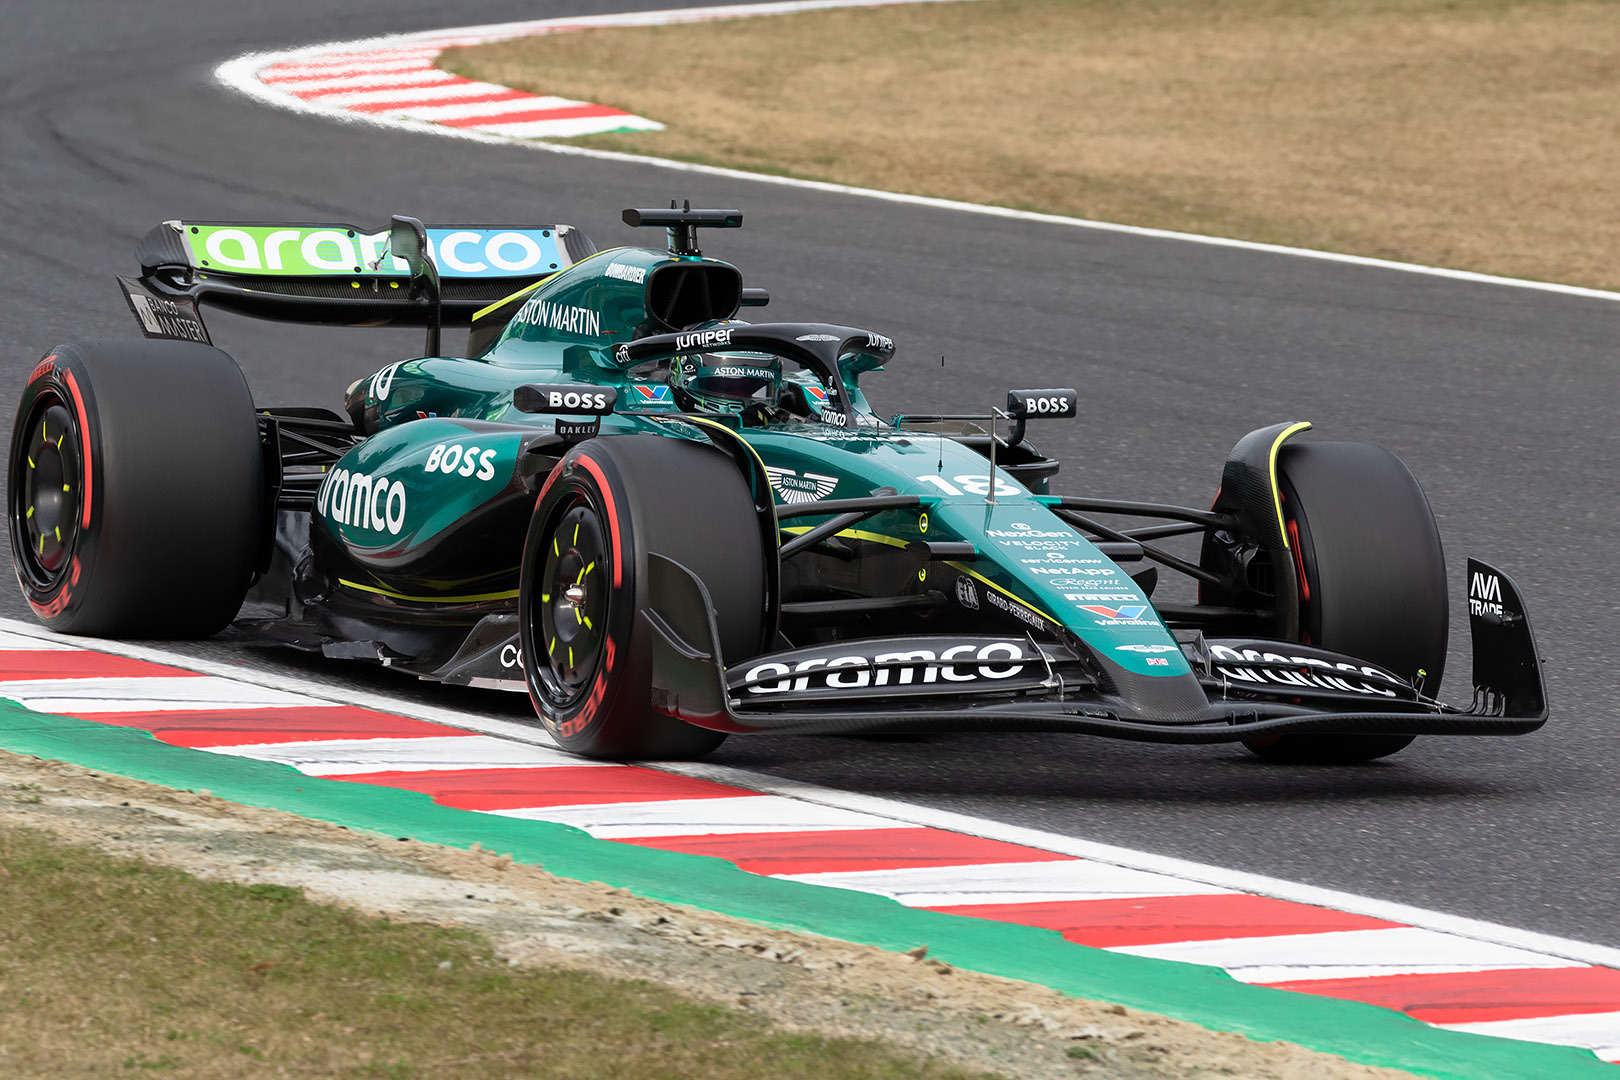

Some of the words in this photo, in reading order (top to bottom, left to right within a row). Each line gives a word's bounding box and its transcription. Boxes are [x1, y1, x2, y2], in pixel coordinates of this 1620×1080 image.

[147, 298, 178, 316] BANCO
[513, 299, 550, 328] ASTON
[549, 302, 600, 337] MARTIN
[158, 315, 206, 342] MASTER
[714, 367, 745, 376] ASTON
[746, 368, 775, 379] MARTIN
[549, 391, 606, 409] BOSS
[1025, 397, 1069, 414] BOSS
[560, 425, 596, 434] OAKLEY
[424, 444, 498, 482] BOSS
[782, 477, 797, 488] ASTON
[798, 481, 817, 491] MARTIN
[916, 474, 1021, 496] 18
[1029, 566, 1116, 576] NetApp
[1470, 571, 1502, 603] AVA
[1470, 598, 1503, 618] TRADE
[745, 642, 1024, 694] aramco
